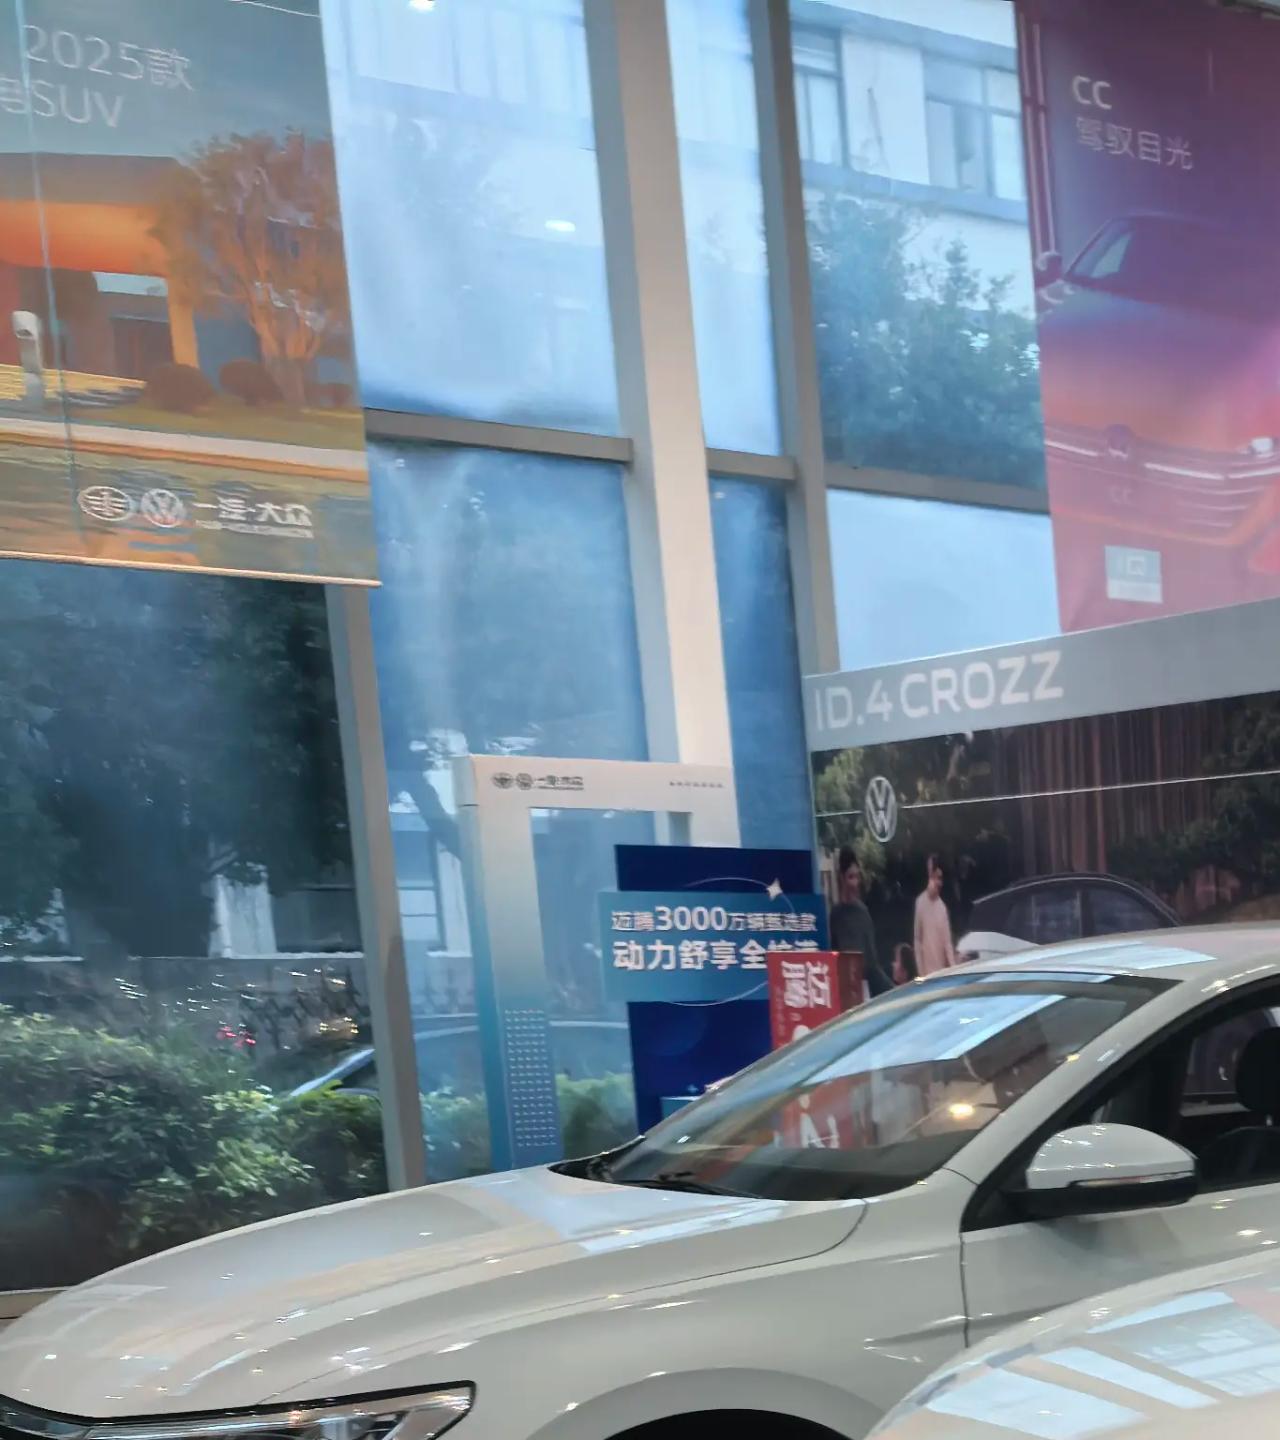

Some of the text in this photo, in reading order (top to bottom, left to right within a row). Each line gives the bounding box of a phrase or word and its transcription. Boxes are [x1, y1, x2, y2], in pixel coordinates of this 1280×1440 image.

[22, 24, 195, 91] 2025款
[1072, 75, 1113, 110] CC
[1075, 116, 1194, 170] 驾驭目光
[900, 650, 1065, 719] CROZZ
[612, 939, 821, 970] 动力舒享全
